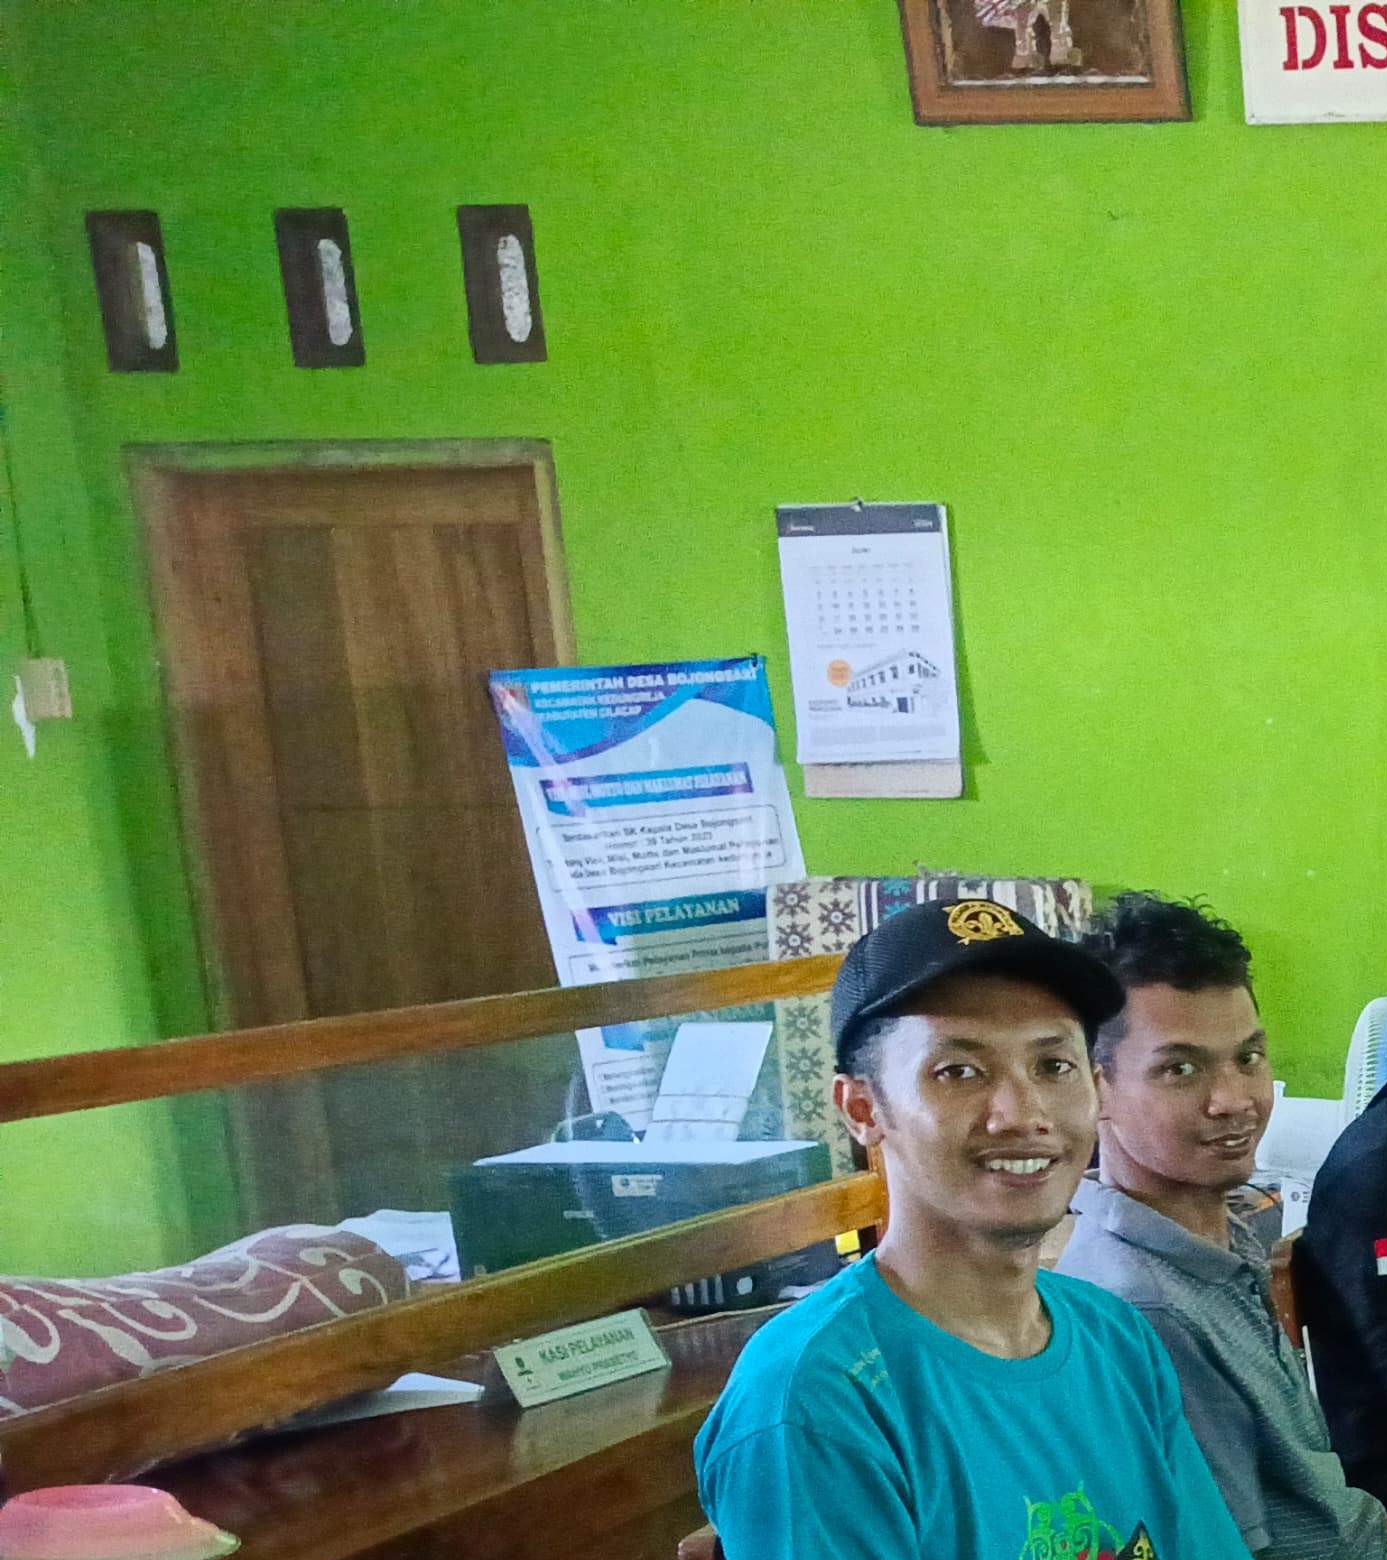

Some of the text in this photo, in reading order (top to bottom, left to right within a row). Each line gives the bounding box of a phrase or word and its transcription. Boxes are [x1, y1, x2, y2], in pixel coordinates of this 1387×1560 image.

[530, 667, 758, 694] PEMERINTAH DESA BOJONGSARI
[599, 705, 643, 718] CILACAP
[608, 898, 740, 928] VISI PELAYANAN
[538, 1328, 635, 1365] KASI PELAYANAN
